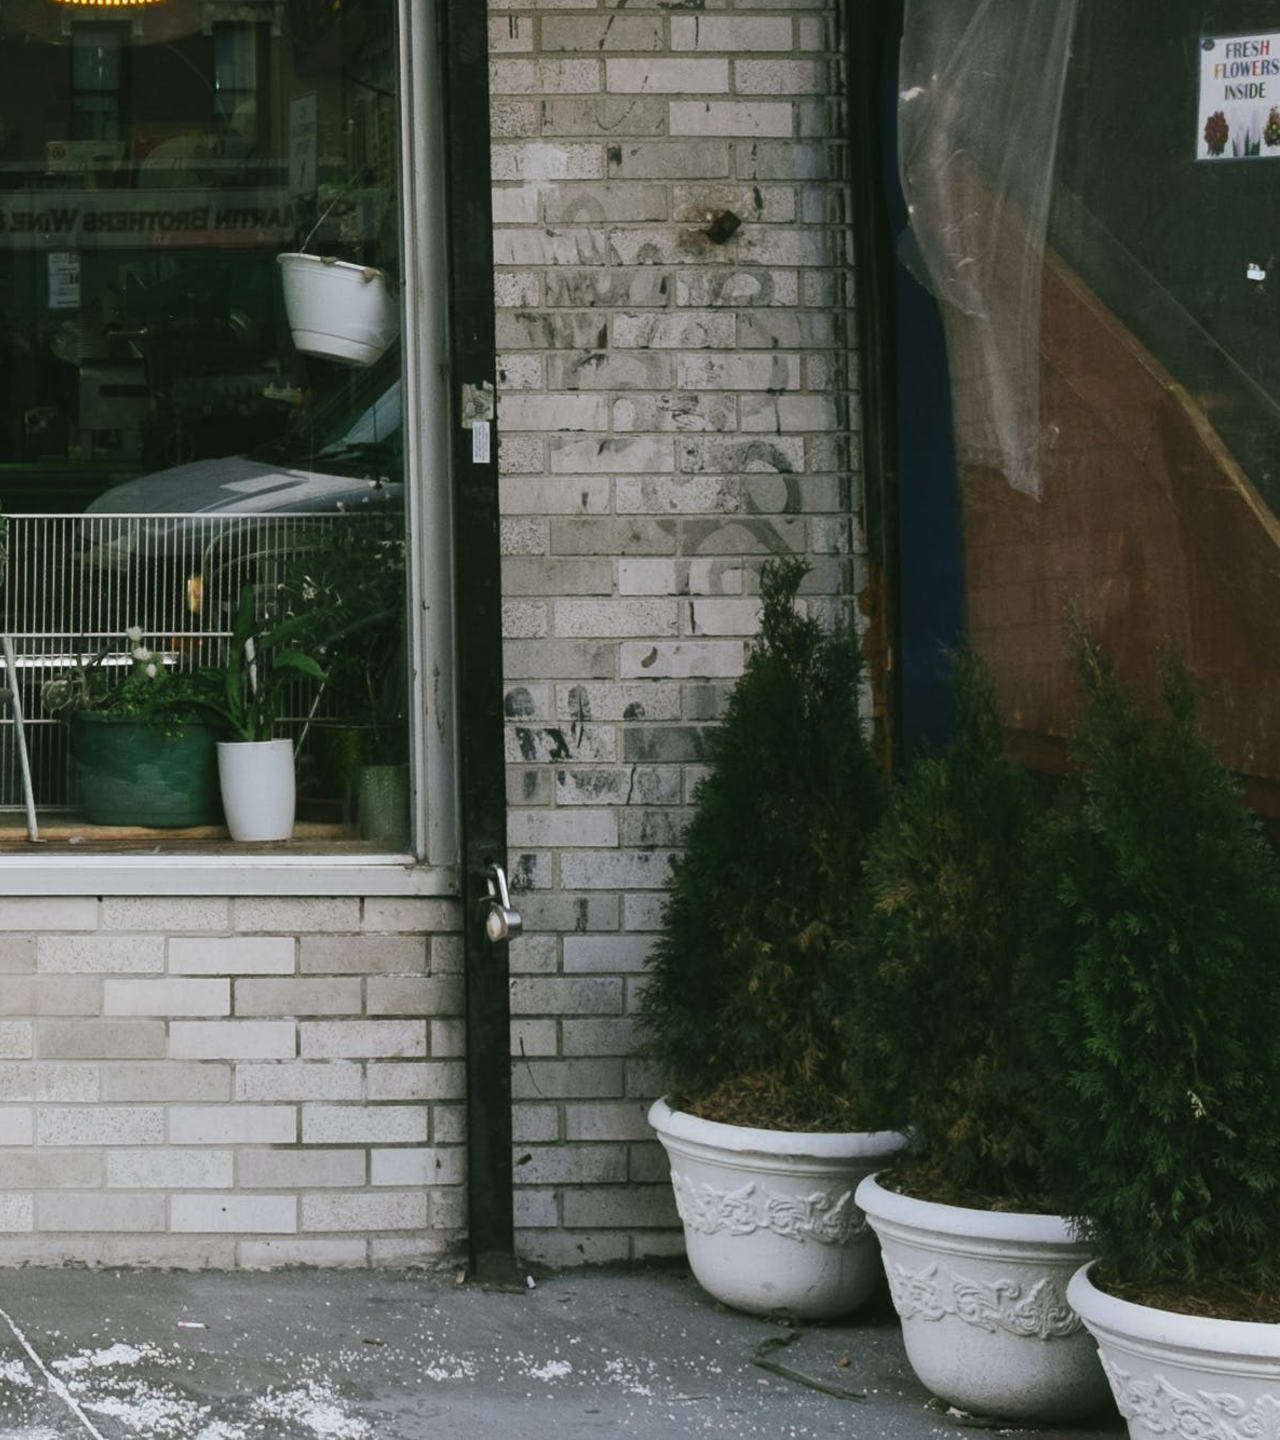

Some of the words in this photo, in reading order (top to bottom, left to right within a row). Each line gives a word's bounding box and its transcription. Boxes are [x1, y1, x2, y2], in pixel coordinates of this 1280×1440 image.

[1225, 40, 1271, 59] FRESH
[1214, 59, 1280, 79] FLOWERS
[1224, 81, 1267, 101] INSIDE
